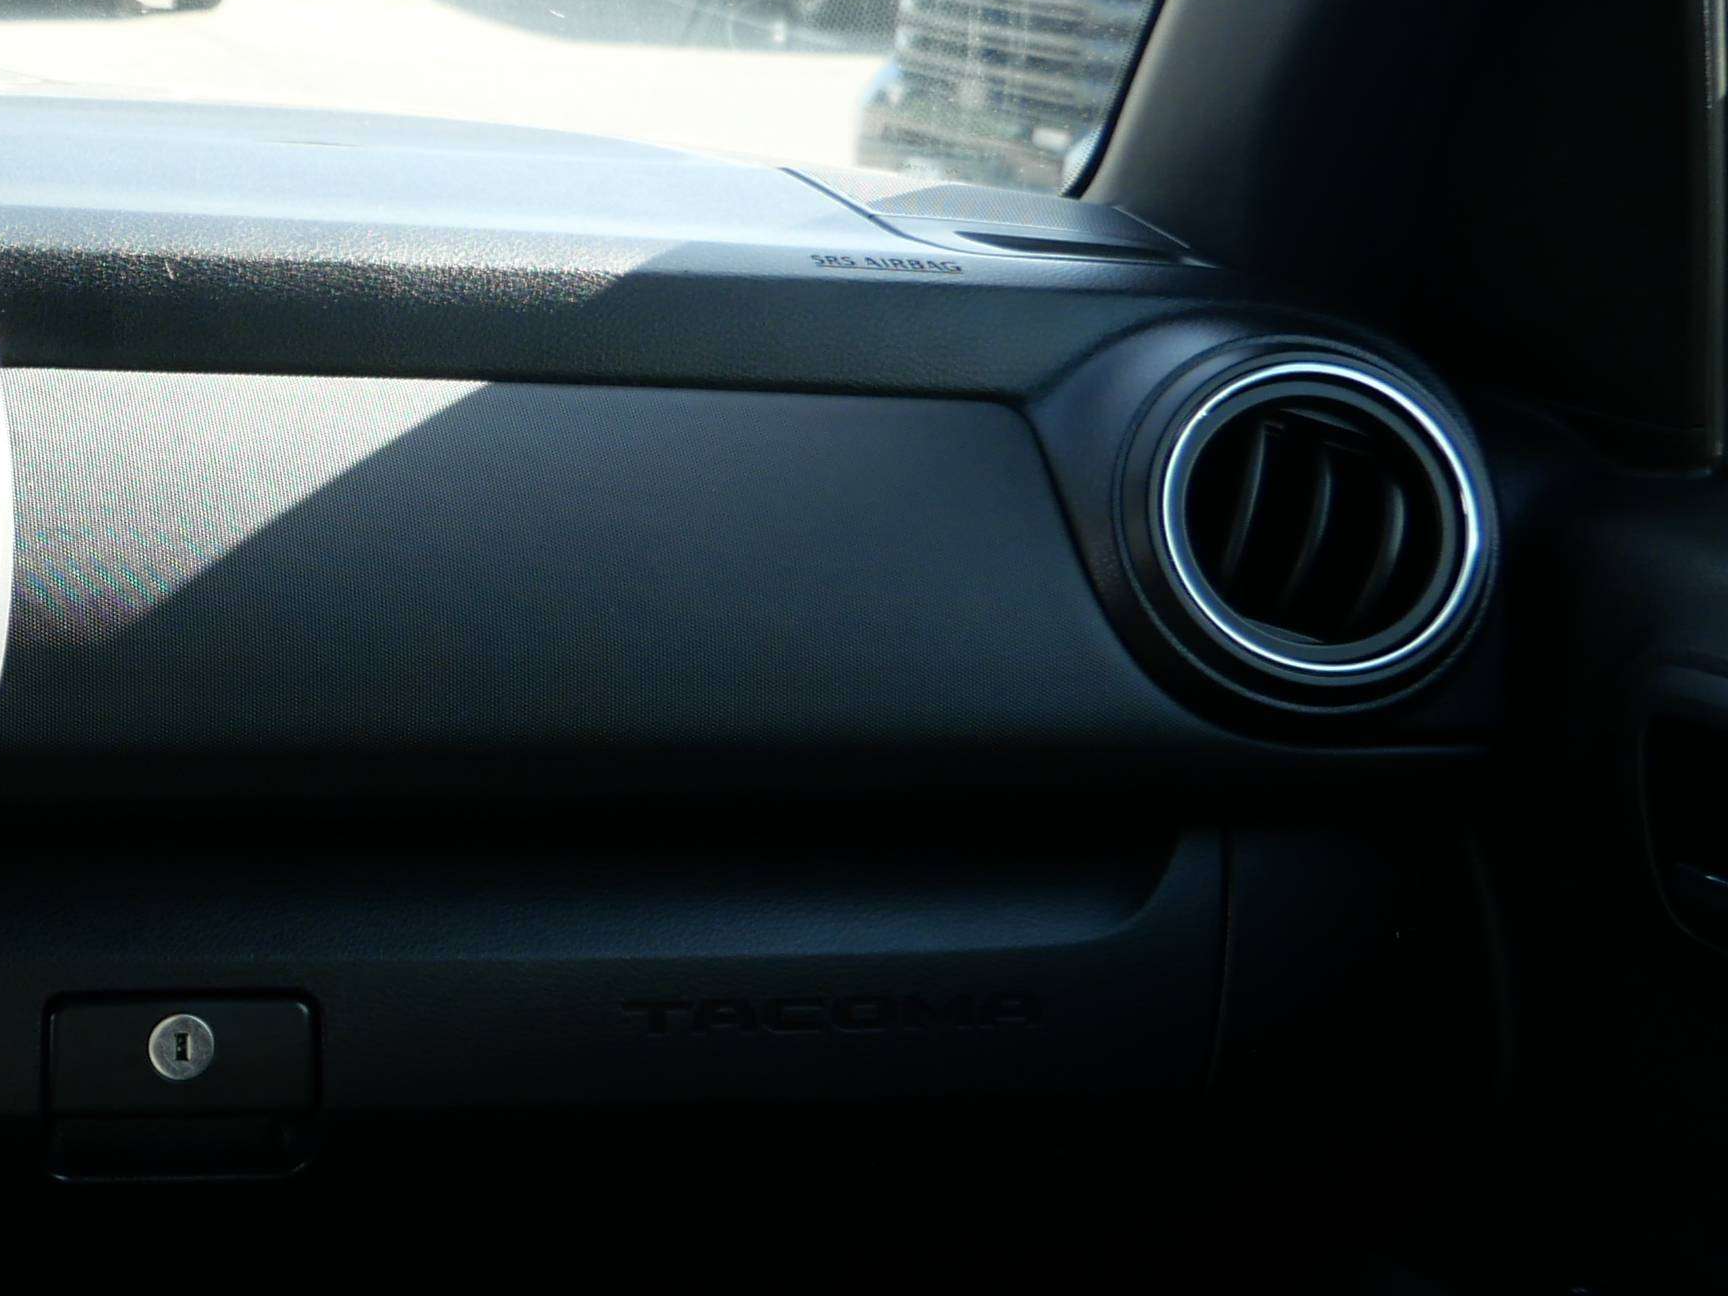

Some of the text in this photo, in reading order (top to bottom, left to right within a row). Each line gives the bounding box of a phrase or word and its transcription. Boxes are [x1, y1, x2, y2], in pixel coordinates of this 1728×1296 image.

[810, 253, 963, 273] SRS AIRBAG
[621, 993, 1047, 1041] TACOMA
